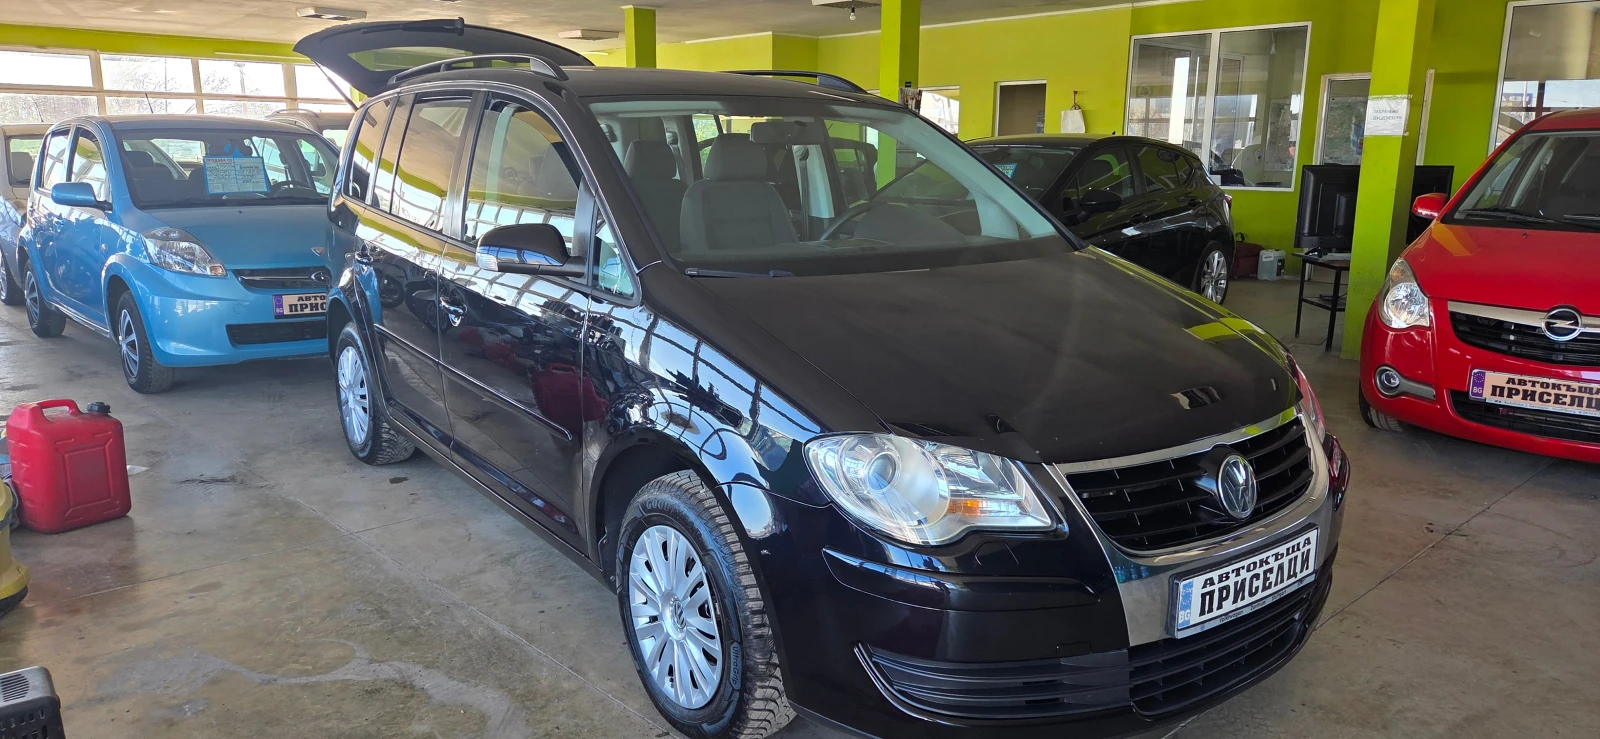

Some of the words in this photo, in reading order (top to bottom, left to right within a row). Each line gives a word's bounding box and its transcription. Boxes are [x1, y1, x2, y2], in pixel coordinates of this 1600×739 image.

[1472, 386, 1483, 394] BG
[1201, 536, 1312, 590] АВТОКЪЩА
[1198, 548, 1312, 618] ПРИСЕЛЦИ
[1178, 609, 1191, 622] BG
